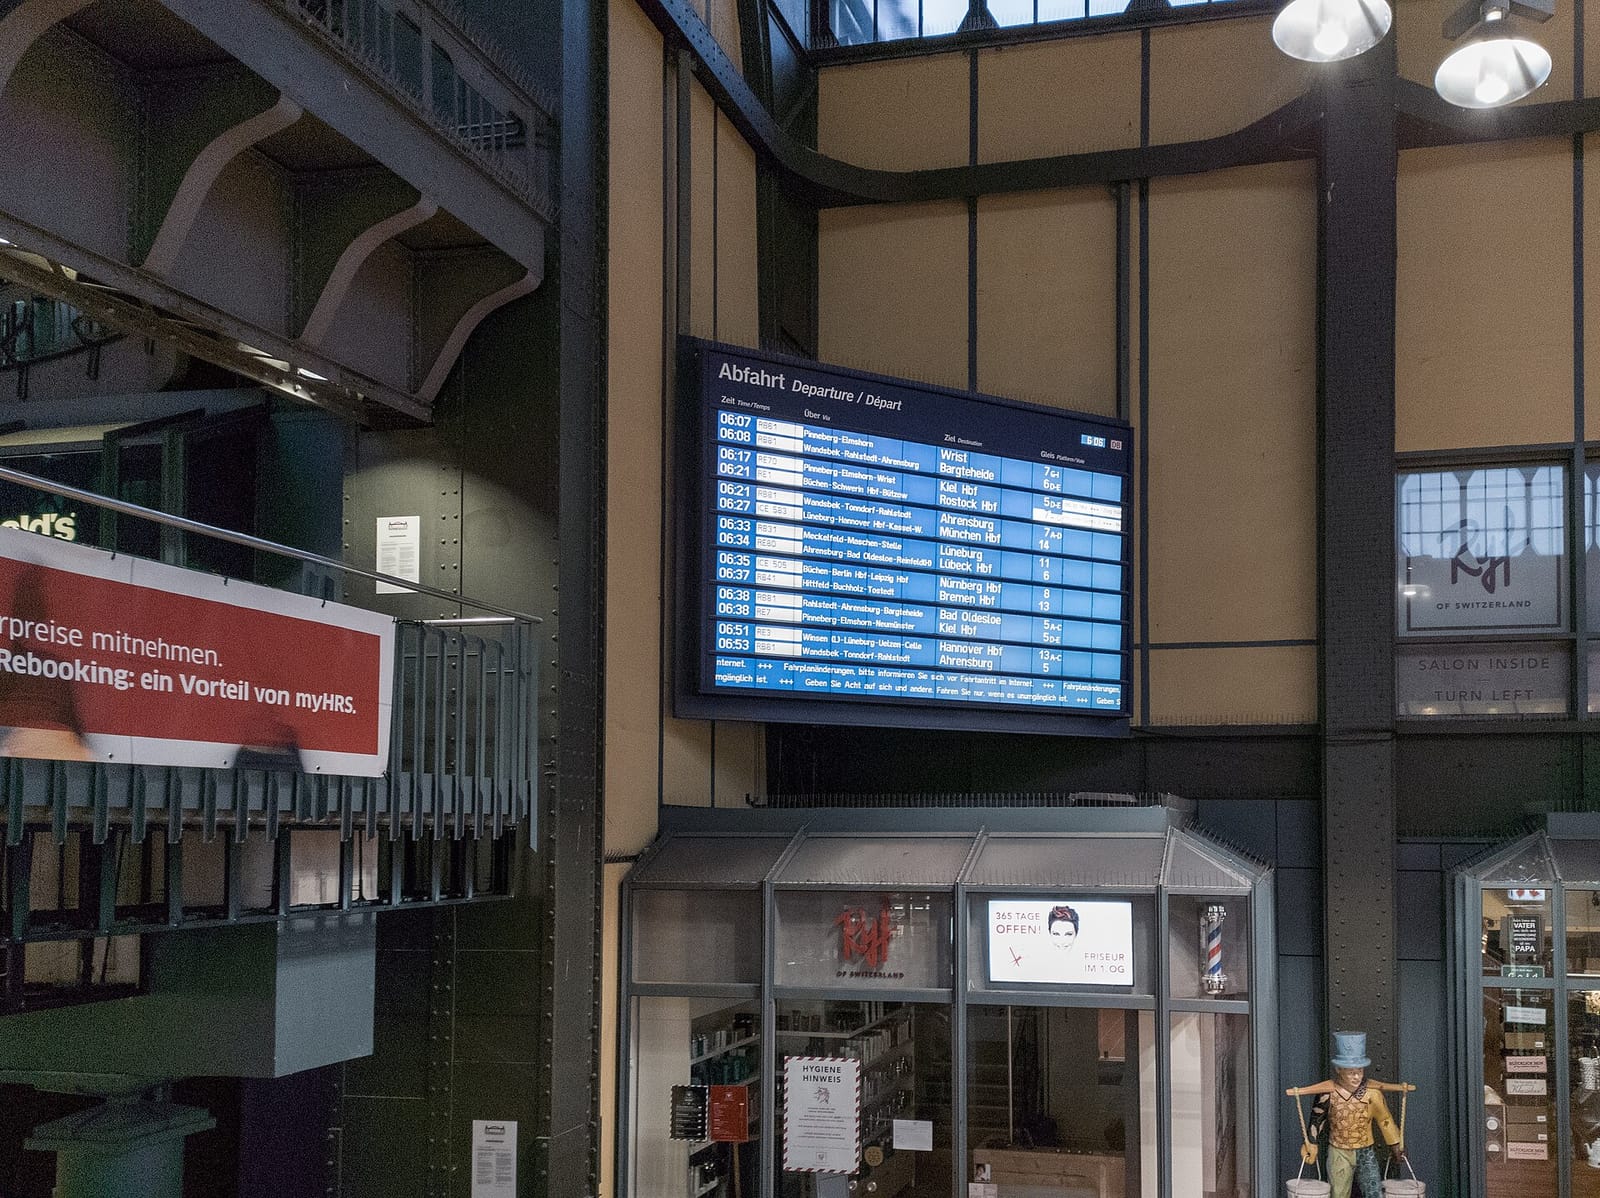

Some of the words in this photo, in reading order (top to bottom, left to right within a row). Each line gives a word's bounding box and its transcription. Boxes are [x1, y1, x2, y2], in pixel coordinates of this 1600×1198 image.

[718, 362, 785, 390] Abfahrt
[792, 380, 854, 402] Departure
[866, 394, 902, 410] Départ
[721, 396, 736, 405] Zeit
[804, 409, 820, 420] Über
[720, 413, 751, 427] 06:07
[941, 449, 967, 463] Wrist
[944, 434, 956, 442] Ziel
[1112, 440, 1121, 450] DB
[720, 427, 750, 442] 06:08
[940, 462, 994, 480] Bargteheide
[1040, 450, 1055, 459] Gleis
[720, 448, 751, 462] 06:17
[758, 455, 777, 465] RE70
[940, 481, 957, 493] Kiel
[962, 484, 978, 496] Hbf
[720, 462, 749, 476] 06:21
[758, 470, 771, 478] RE1
[940, 494, 977, 509] Rostock
[982, 500, 997, 512] Hbf
[720, 483, 749, 497] 06:21
[940, 513, 994, 531] Ahrensburg
[720, 497, 750, 511] 06:27
[940, 526, 981, 541] München
[985, 532, 1000, 543] Hbf
[1039, 540, 1049, 550] 14
[720, 518, 750, 531] 06:33
[940, 545, 982, 561] Lüneburg
[1040, 558, 1049, 568] 11
[720, 532, 750, 546] 06:34
[940, 558, 972, 571] Lübeck
[976, 563, 992, 573] Hbf
[1043, 571, 1049, 580] 6
[720, 553, 750, 566] 06:35
[758, 558, 768, 567] ICE
[940, 577, 982, 593] Nürnberg
[986, 582, 1001, 593] Hbf
[1044, 589, 1050, 598] 8
[719, 567, 750, 580] 06:37
[940, 590, 975, 604] Bremen
[979, 595, 995, 605] Hbf
[1039, 601, 1050, 611] 13
[719, 588, 750, 601] 06:38
[940, 609, 957, 620] Bad
[961, 612, 1001, 625] Oldesloe
[1436, 602, 1451, 610] OF
[1455, 600, 1532, 610] SWITZERLAND
[719, 602, 749, 615] 06:38
[756, 608, 771, 616] RE7
[939, 622, 956, 633] Kiel
[961, 624, 976, 635] Hbf
[0, 614, 83, 647] rpreise
[92, 630, 224, 668] mitnehmen.
[719, 623, 748, 636] 06:51
[803, 633, 828, 642] Winsen
[940, 642, 983, 654] Hannover
[987, 646, 1003, 656] Hbf
[719, 638, 749, 650] 06:53
[940, 655, 993, 670] Ahrensburg
[1043, 663, 1049, 672] 5
[1418, 658, 1480, 672] SALON
[1489, 656, 1551, 670] INSIDE
[0, 649, 135, 690] Rebooking:
[140, 669, 174, 692] ein
[179, 674, 249, 702] Vorteil
[254, 686, 290, 706] von
[296, 690, 357, 716] myHRS.
[805, 678, 827, 686] Geben
[858, 668, 874, 676] bitte
[878, 670, 915, 678] informieren
[960, 675, 996, 684] Fahrtantritt
[1434, 690, 1482, 702] TURN
[1492, 689, 1535, 702] LEFT
[996, 912, 1013, 920] 365
[1016, 912, 1040, 921] TAGE
[996, 924, 1041, 935] OFFEN!
[1084, 952, 1126, 962] FRISEUR
[1084, 964, 1097, 973] IM
[836, 971, 847, 979] OF
[850, 972, 905, 980] SWITZERLAND
[802, 1066, 842, 1074] HYGIENE
[802, 1075, 842, 1084] HINWEIS
